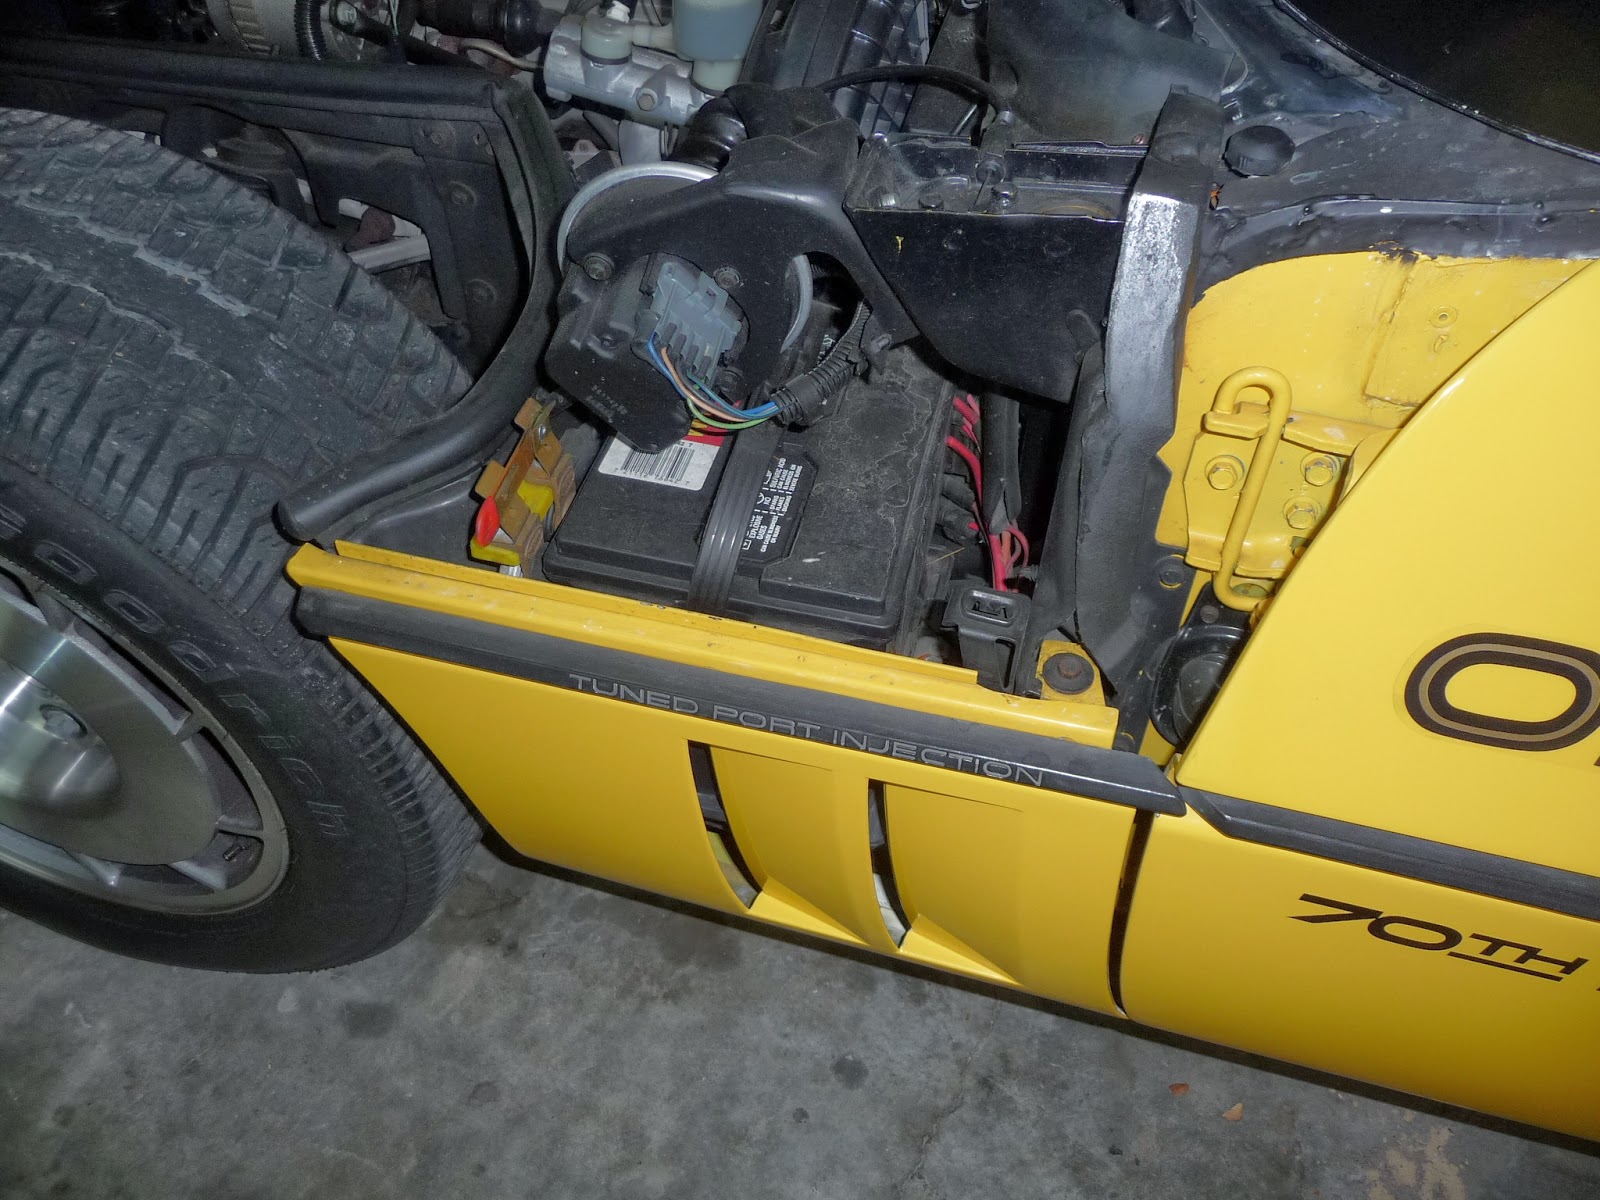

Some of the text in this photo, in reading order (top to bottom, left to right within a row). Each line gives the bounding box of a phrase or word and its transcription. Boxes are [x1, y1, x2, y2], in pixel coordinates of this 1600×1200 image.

[569, 674, 1044, 787] TUNED PORT INJECTION
[1404, 632, 1600, 767] O
[1287, 893, 1589, 982] 70TH
